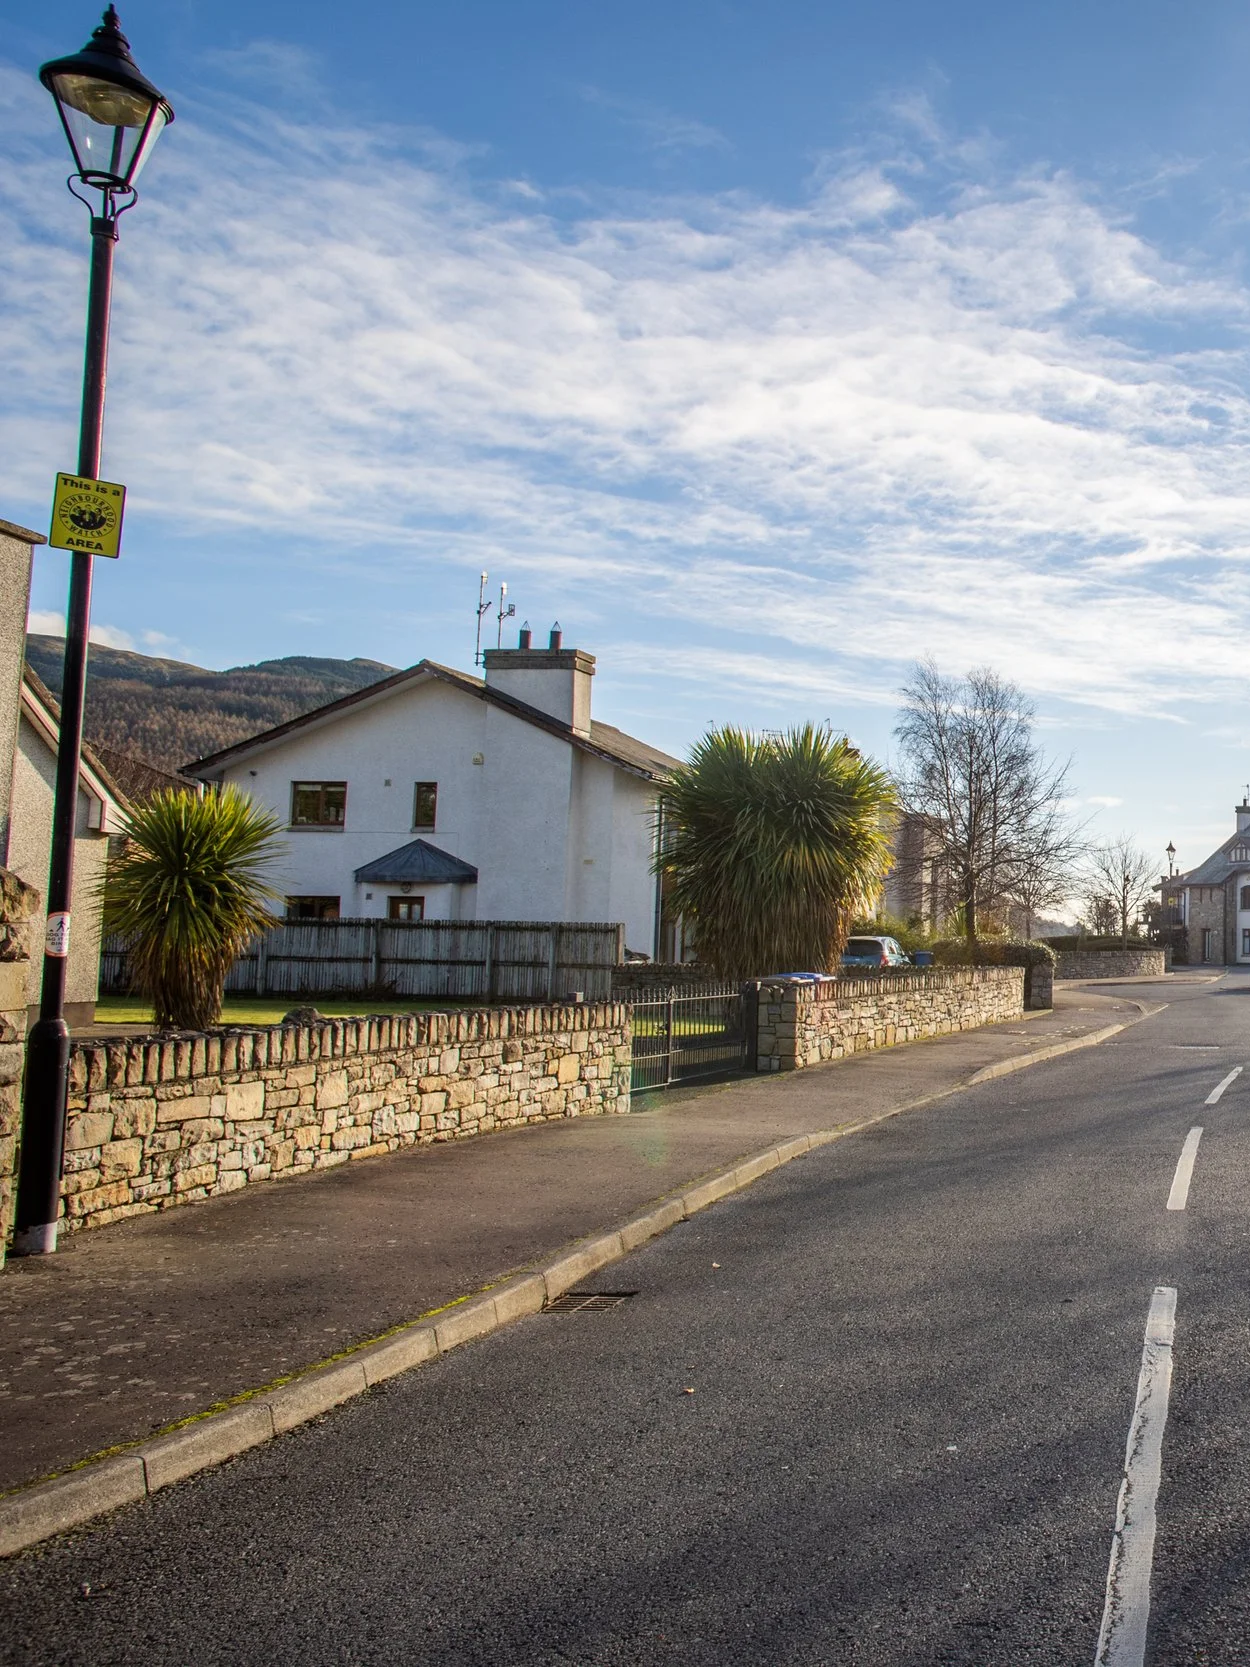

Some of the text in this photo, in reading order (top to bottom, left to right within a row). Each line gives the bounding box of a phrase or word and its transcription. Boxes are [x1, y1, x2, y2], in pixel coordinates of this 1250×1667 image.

[62, 477, 91, 490] This
[96, 484, 107, 494] is
[60, 495, 115, 528] NEIGHBOURHOOD
[69, 525, 103, 537] WATCH
[66, 538, 103, 551] AREA
